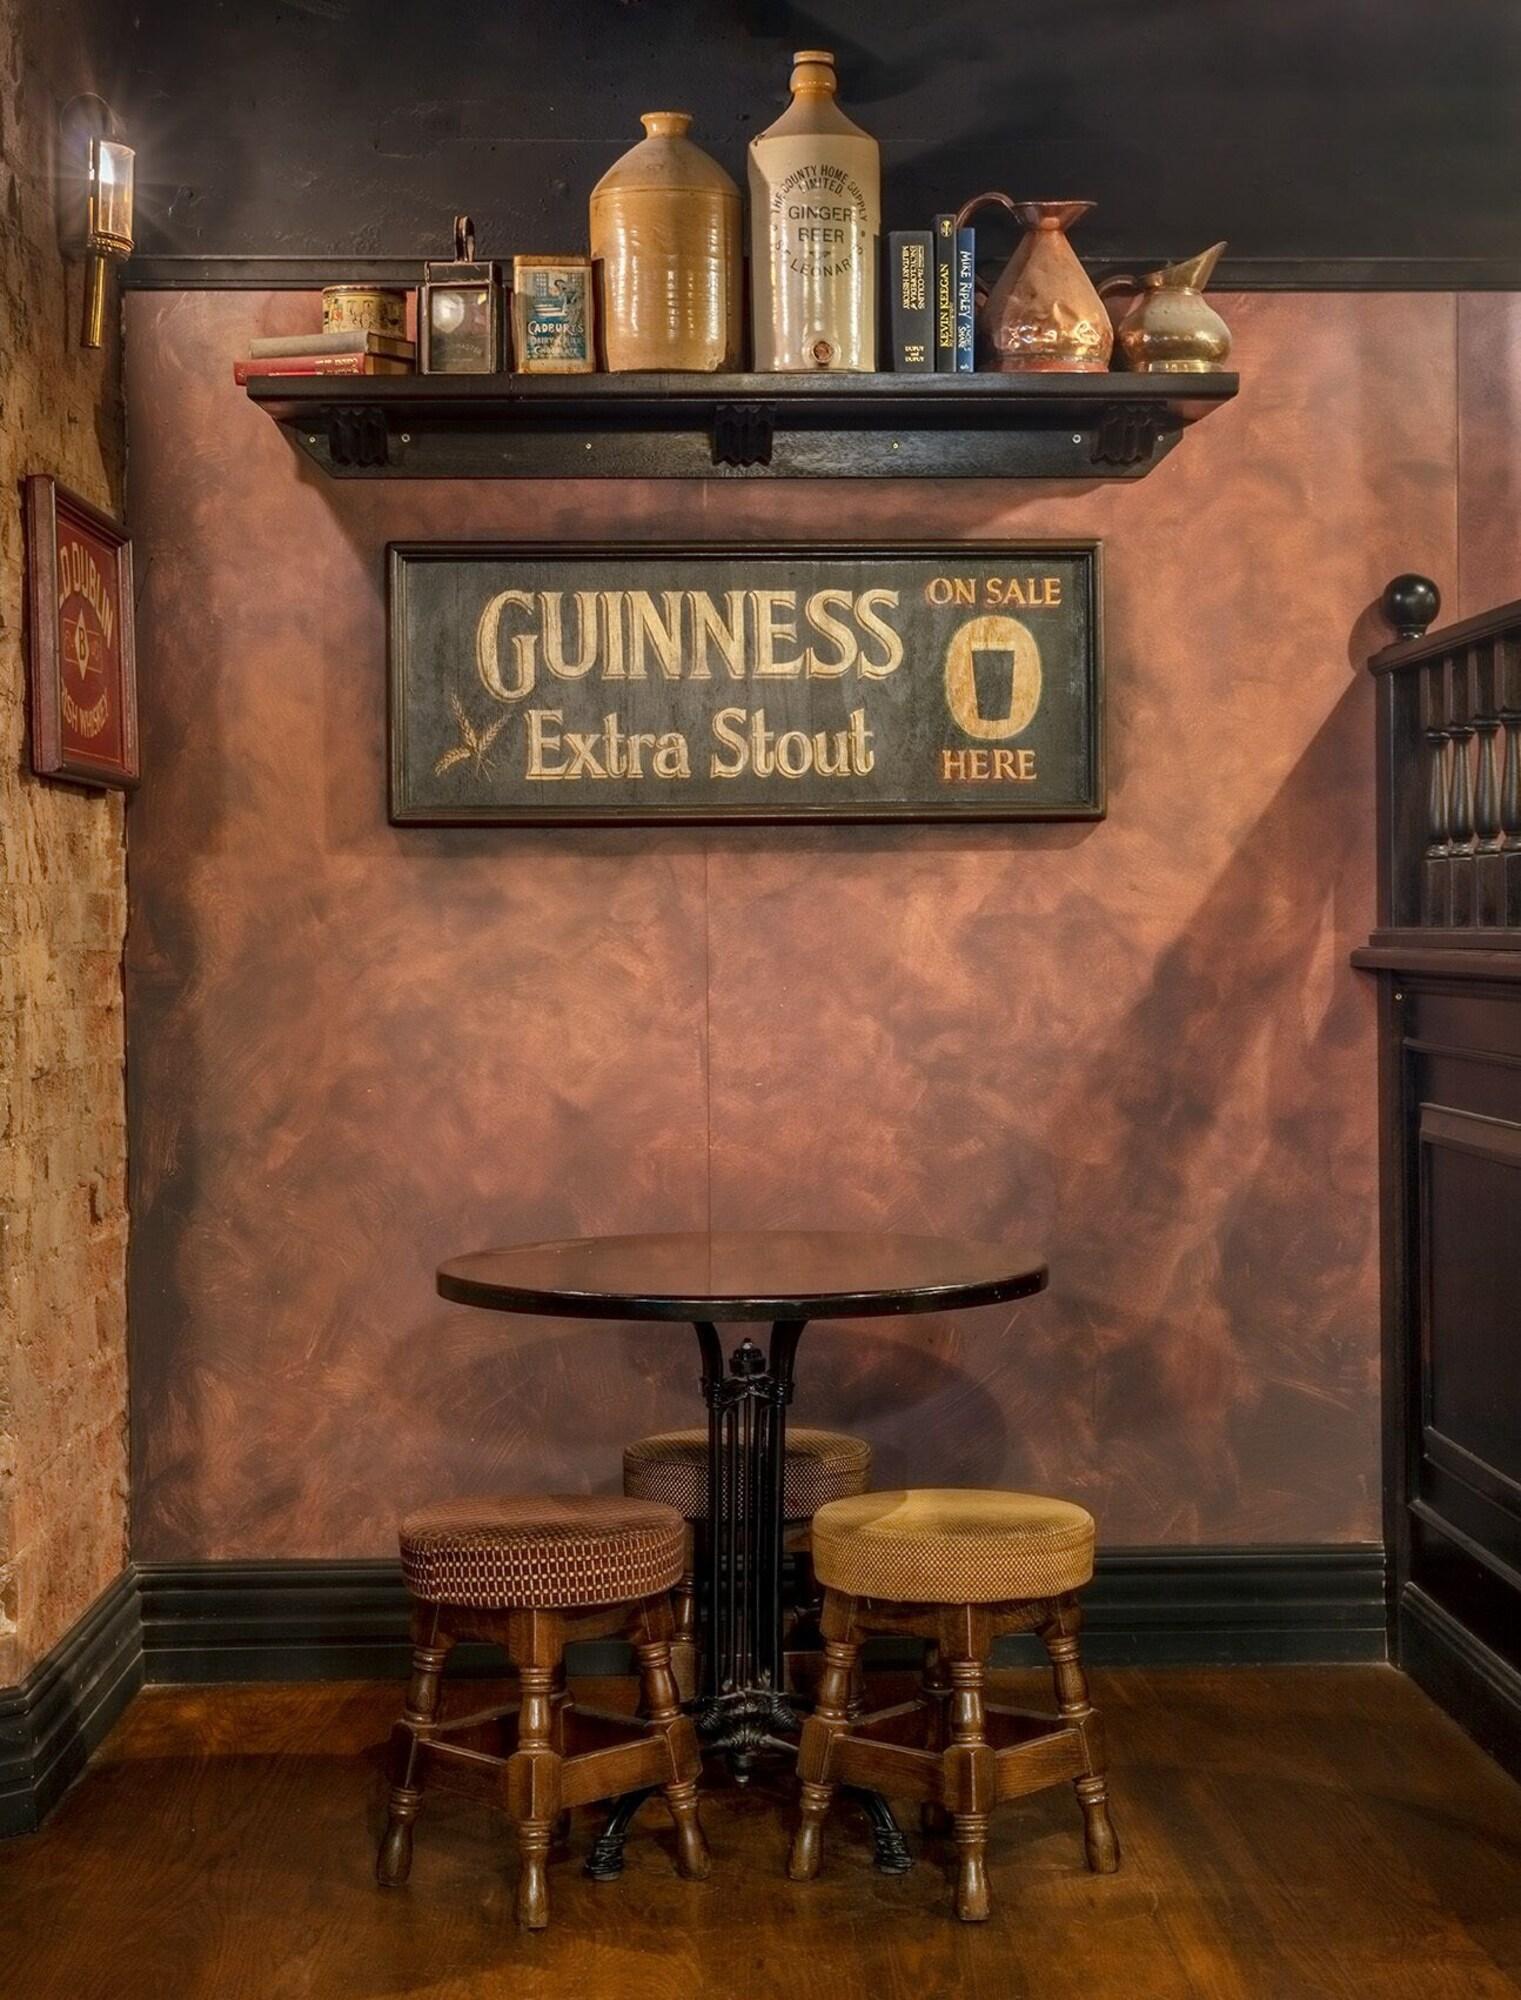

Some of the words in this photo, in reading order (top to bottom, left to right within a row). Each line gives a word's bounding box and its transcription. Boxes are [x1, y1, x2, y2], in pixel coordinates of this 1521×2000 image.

[783, 164, 818, 194] COUNTY
[820, 164, 849, 185] HOME
[847, 181, 869, 222] SUPPLY
[788, 205, 854, 222] GINGER
[798, 227, 845, 243] BEER
[959, 250, 972, 278] MIKE
[902, 279, 910, 310] HISTORY
[940, 264, 949, 309] KEEGAN
[958, 282, 972, 320] RIPLEY
[940, 312, 949, 347] KEVIN
[71, 542, 114, 649] DUBLIN
[926, 577, 977, 605] ON
[985, 577, 1063, 606] SALE
[78, 628, 86, 661] B
[476, 589, 904, 704] GUINNESS
[524, 708, 692, 781] Extra
[710, 706, 876, 780] Stout
[940, 748, 1038, 781] HERE
